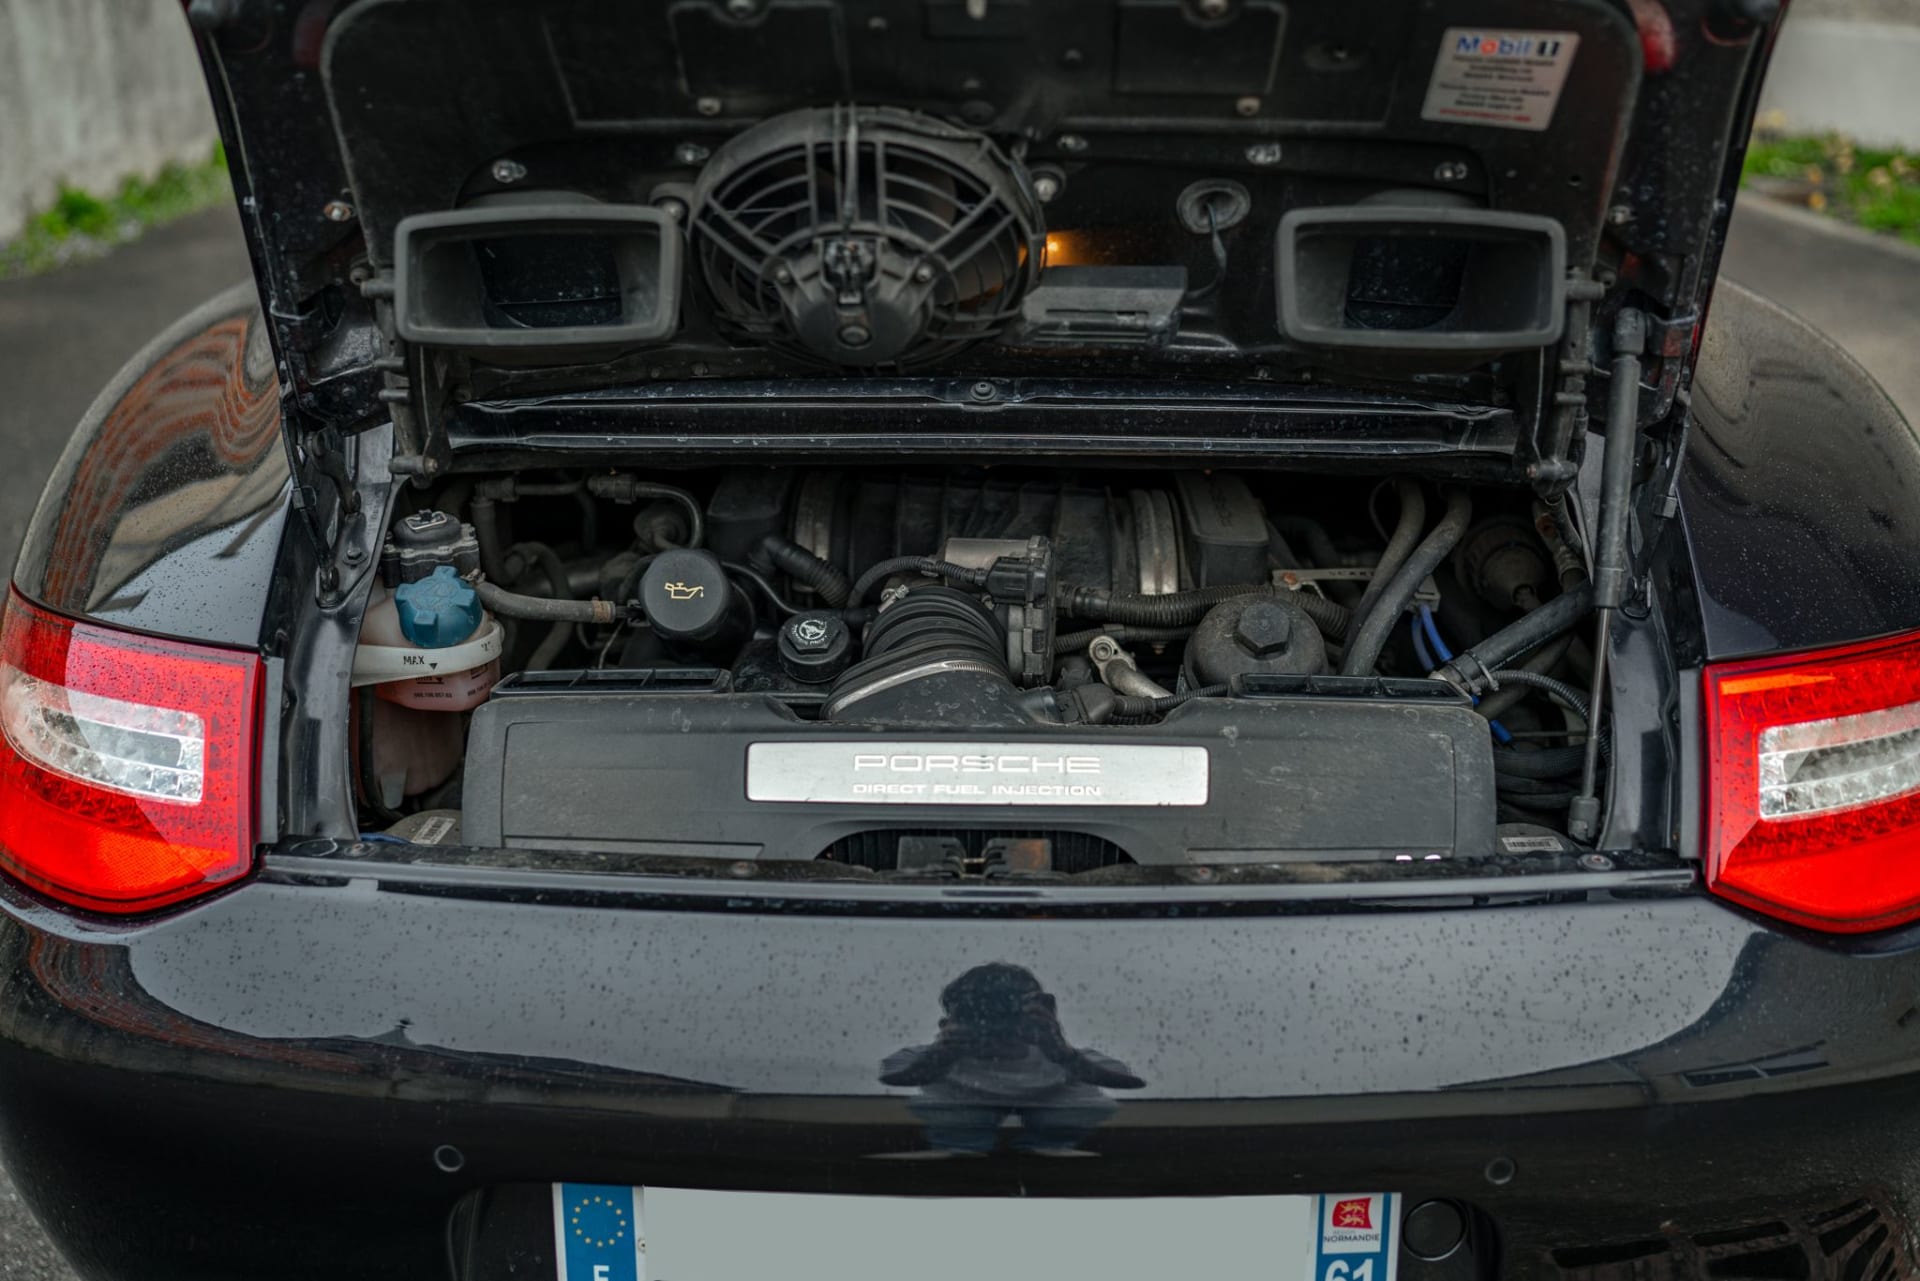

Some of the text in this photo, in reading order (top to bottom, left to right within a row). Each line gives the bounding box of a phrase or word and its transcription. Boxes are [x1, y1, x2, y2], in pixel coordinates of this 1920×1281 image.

[1457, 35, 1531, 55] Mobil
[403, 655, 425, 665] MAX
[853, 754, 1101, 774] PORSCHE
[853, 783, 1101, 797] DIRECT FUEL INJECTION
[1324, 1233, 1380, 1242] NORMANDIE
[1325, 1258, 1374, 1281] 61
